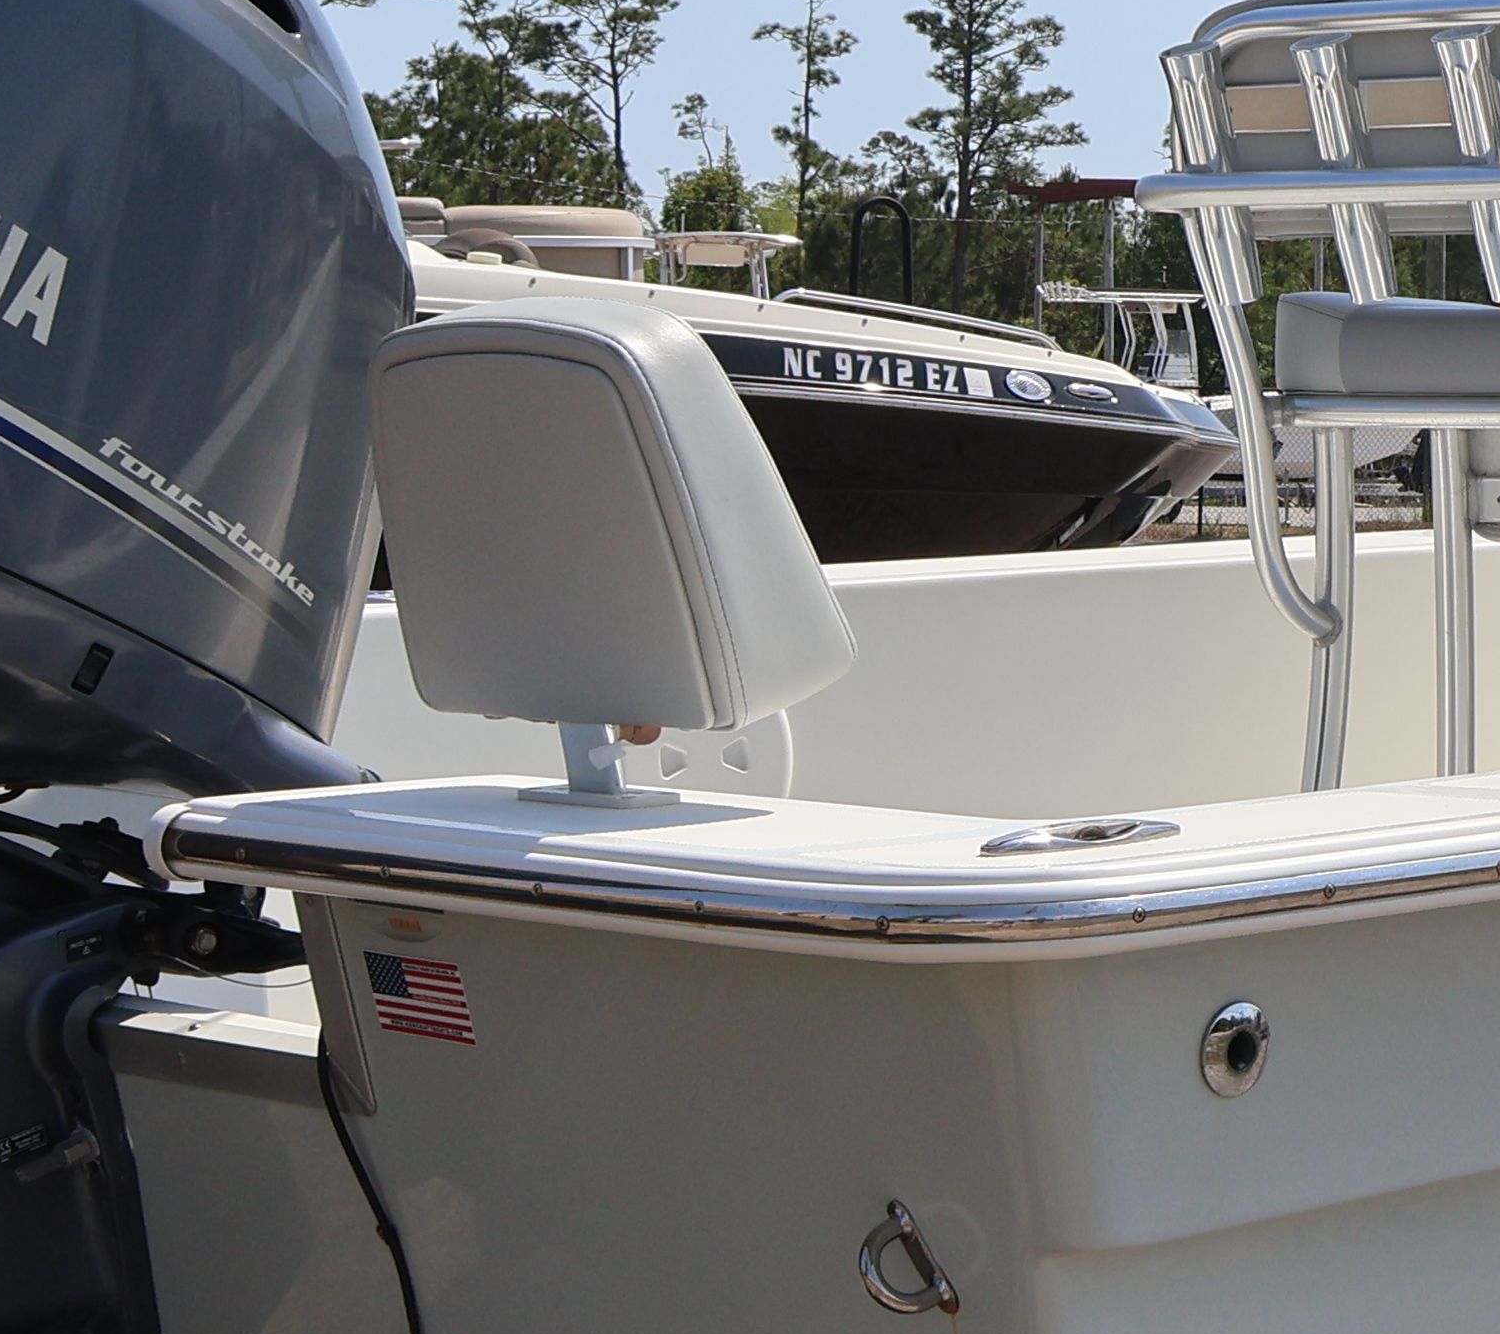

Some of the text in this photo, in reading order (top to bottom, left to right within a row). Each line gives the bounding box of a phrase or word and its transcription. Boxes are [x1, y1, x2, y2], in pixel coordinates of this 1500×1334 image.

[783, 347, 822, 379] NC
[835, 352, 914, 387] 9712
[925, 361, 959, 393] EZ
